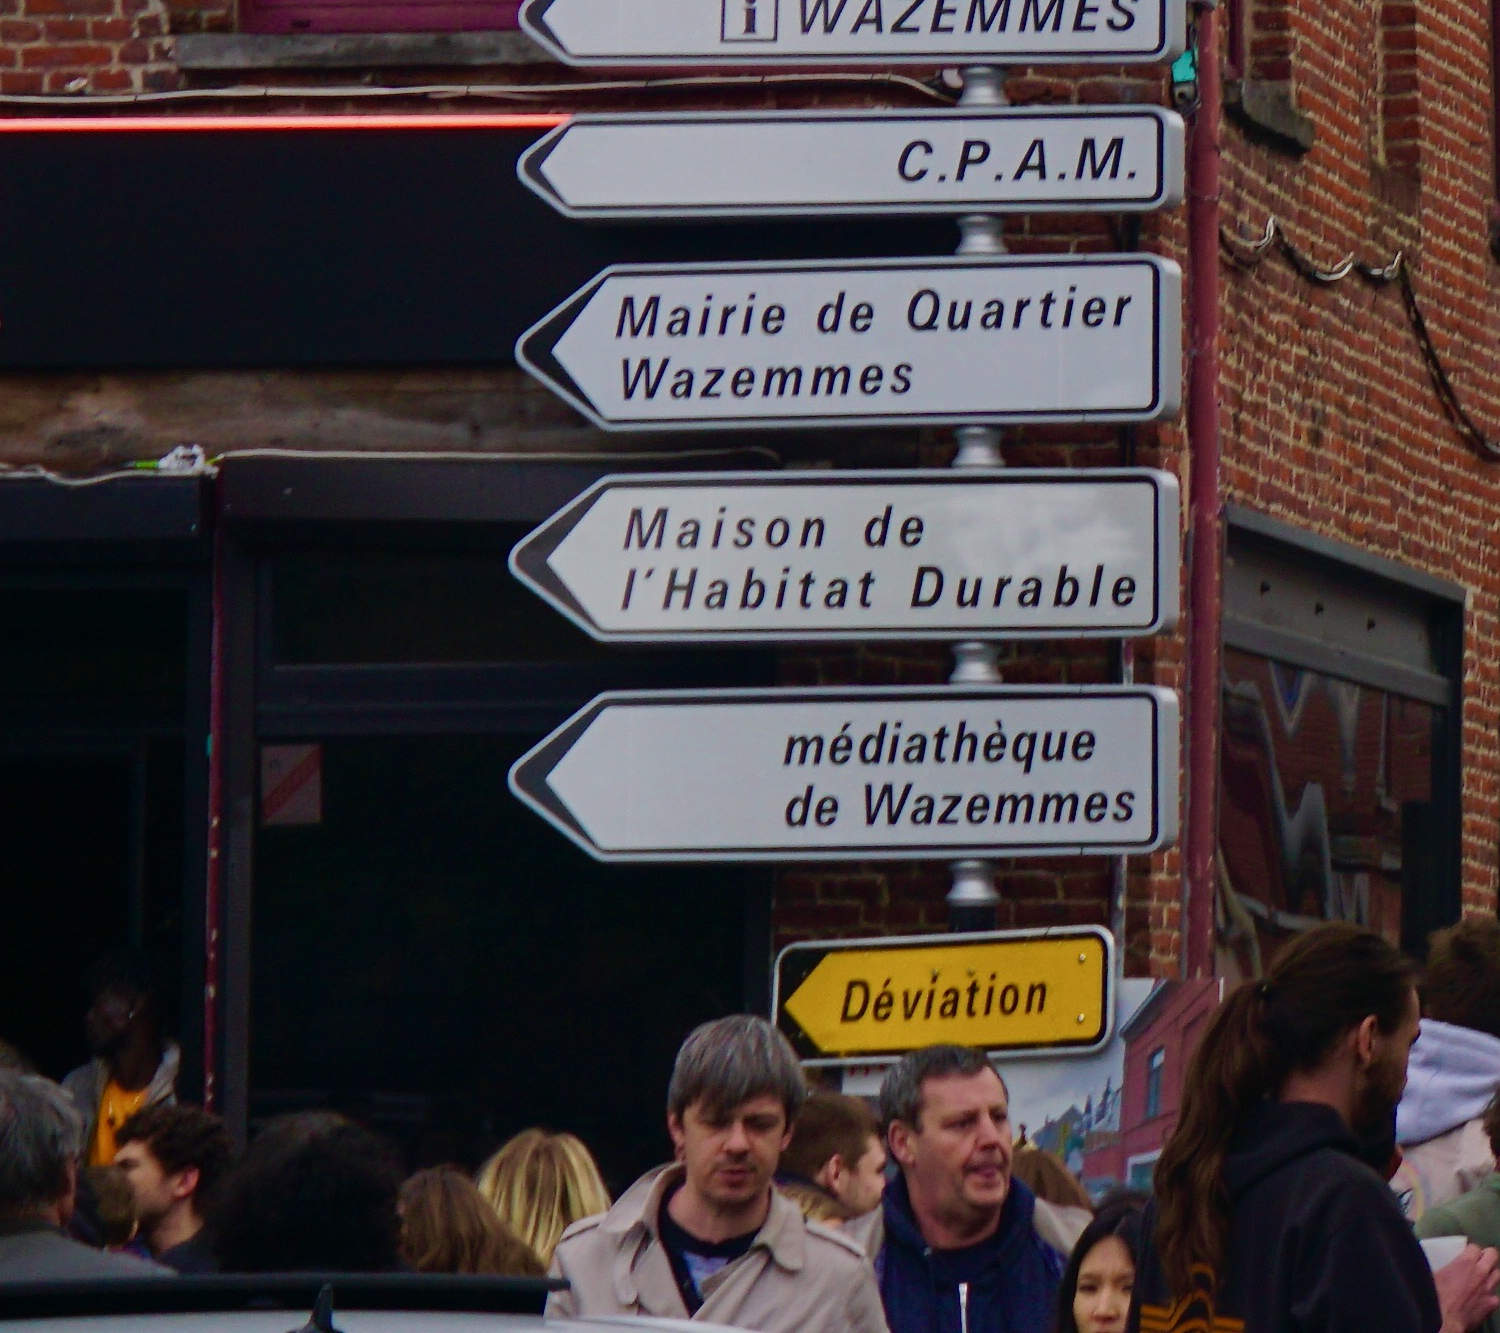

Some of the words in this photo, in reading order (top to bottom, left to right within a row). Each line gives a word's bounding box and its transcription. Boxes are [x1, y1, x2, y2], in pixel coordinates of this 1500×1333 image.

[897, 137, 1139, 183] C.P.A.M.
[616, 293, 787, 339] Mairie
[816, 290, 876, 334] de
[905, 287, 1133, 333] Quartier
[621, 356, 915, 401] Wazemmes
[622, 505, 827, 552] Maison
[864, 505, 925, 548] de
[621, 565, 877, 612] l'Habitat
[910, 563, 1137, 610] Durable
[782, 718, 1097, 773] médiathèque
[785, 785, 840, 828] de
[863, 782, 1137, 828] Wazemmes
[840, 972, 1049, 1024] Déviation
